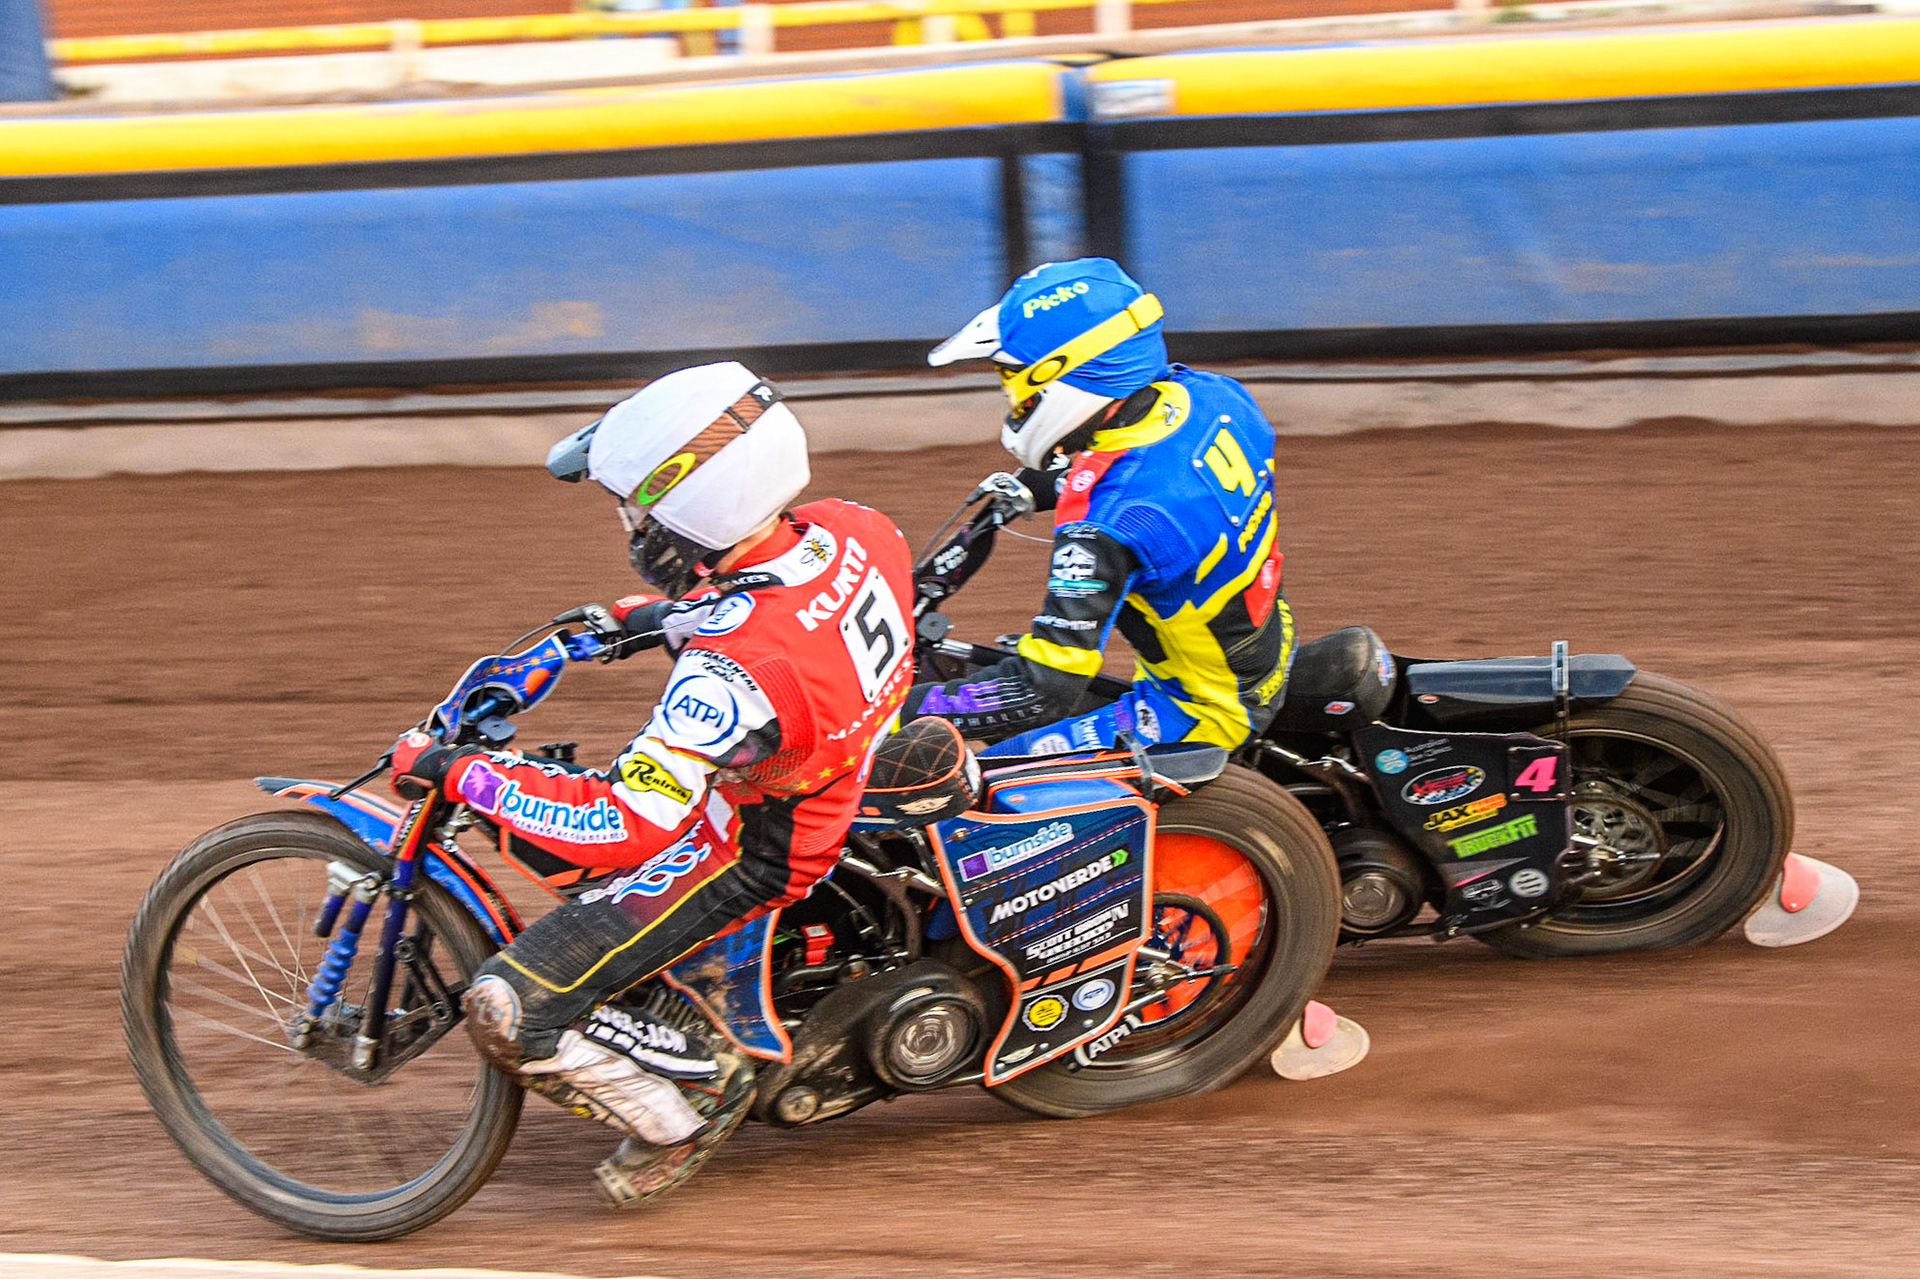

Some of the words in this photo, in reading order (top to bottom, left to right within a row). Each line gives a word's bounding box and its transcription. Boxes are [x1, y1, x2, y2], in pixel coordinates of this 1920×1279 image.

[1023, 282, 1069, 318] Picko
[1203, 427, 1257, 498] 4
[854, 590, 895, 679] 5
[672, 694, 725, 728] ATPI
[1514, 756, 1558, 792] 4
[502, 783, 622, 831] burnside
[1423, 805, 1471, 828] JAX
[990, 821, 1073, 865] burnside
[989, 855, 1113, 925] MOTOVERDE
[1089, 1025, 1131, 1059] ATPI
